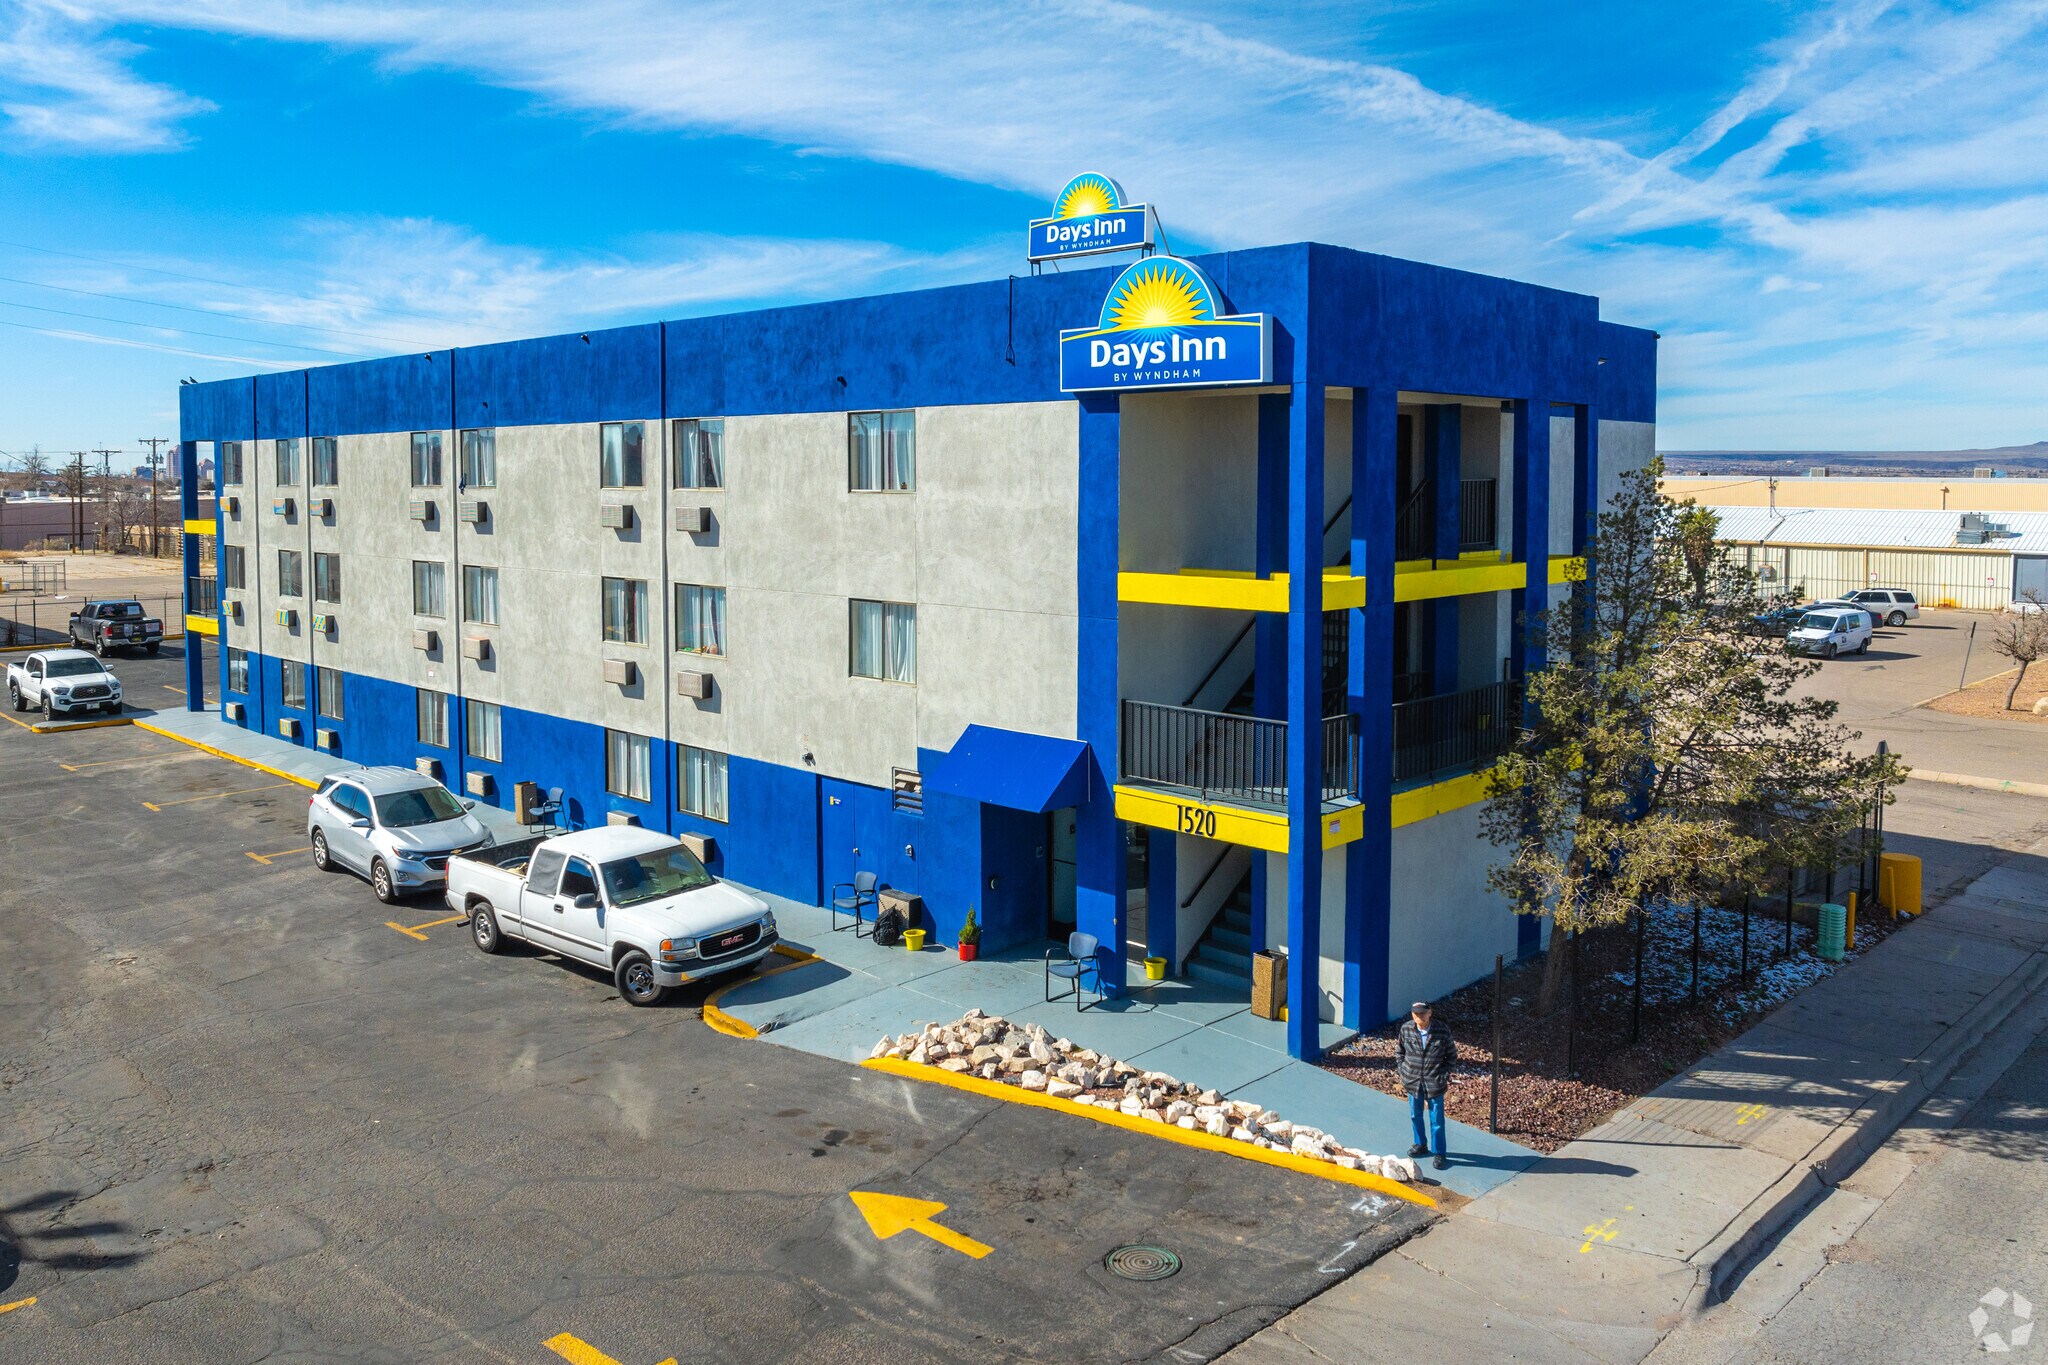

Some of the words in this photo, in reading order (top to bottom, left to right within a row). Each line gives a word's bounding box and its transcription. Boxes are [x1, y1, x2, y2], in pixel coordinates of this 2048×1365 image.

[1046, 223, 1091, 242] Days
[1094, 218, 1126, 236] Inn
[1072, 238, 1111, 249] WYNDHAM
[1090, 340, 1166, 369] Days
[1172, 333, 1226, 362] Inn
[1114, 373, 1128, 382] BY
[1134, 368, 1201, 381] WYNDHAM
[1177, 805, 1216, 837] 1520
[721, 934, 743, 946] GMC
